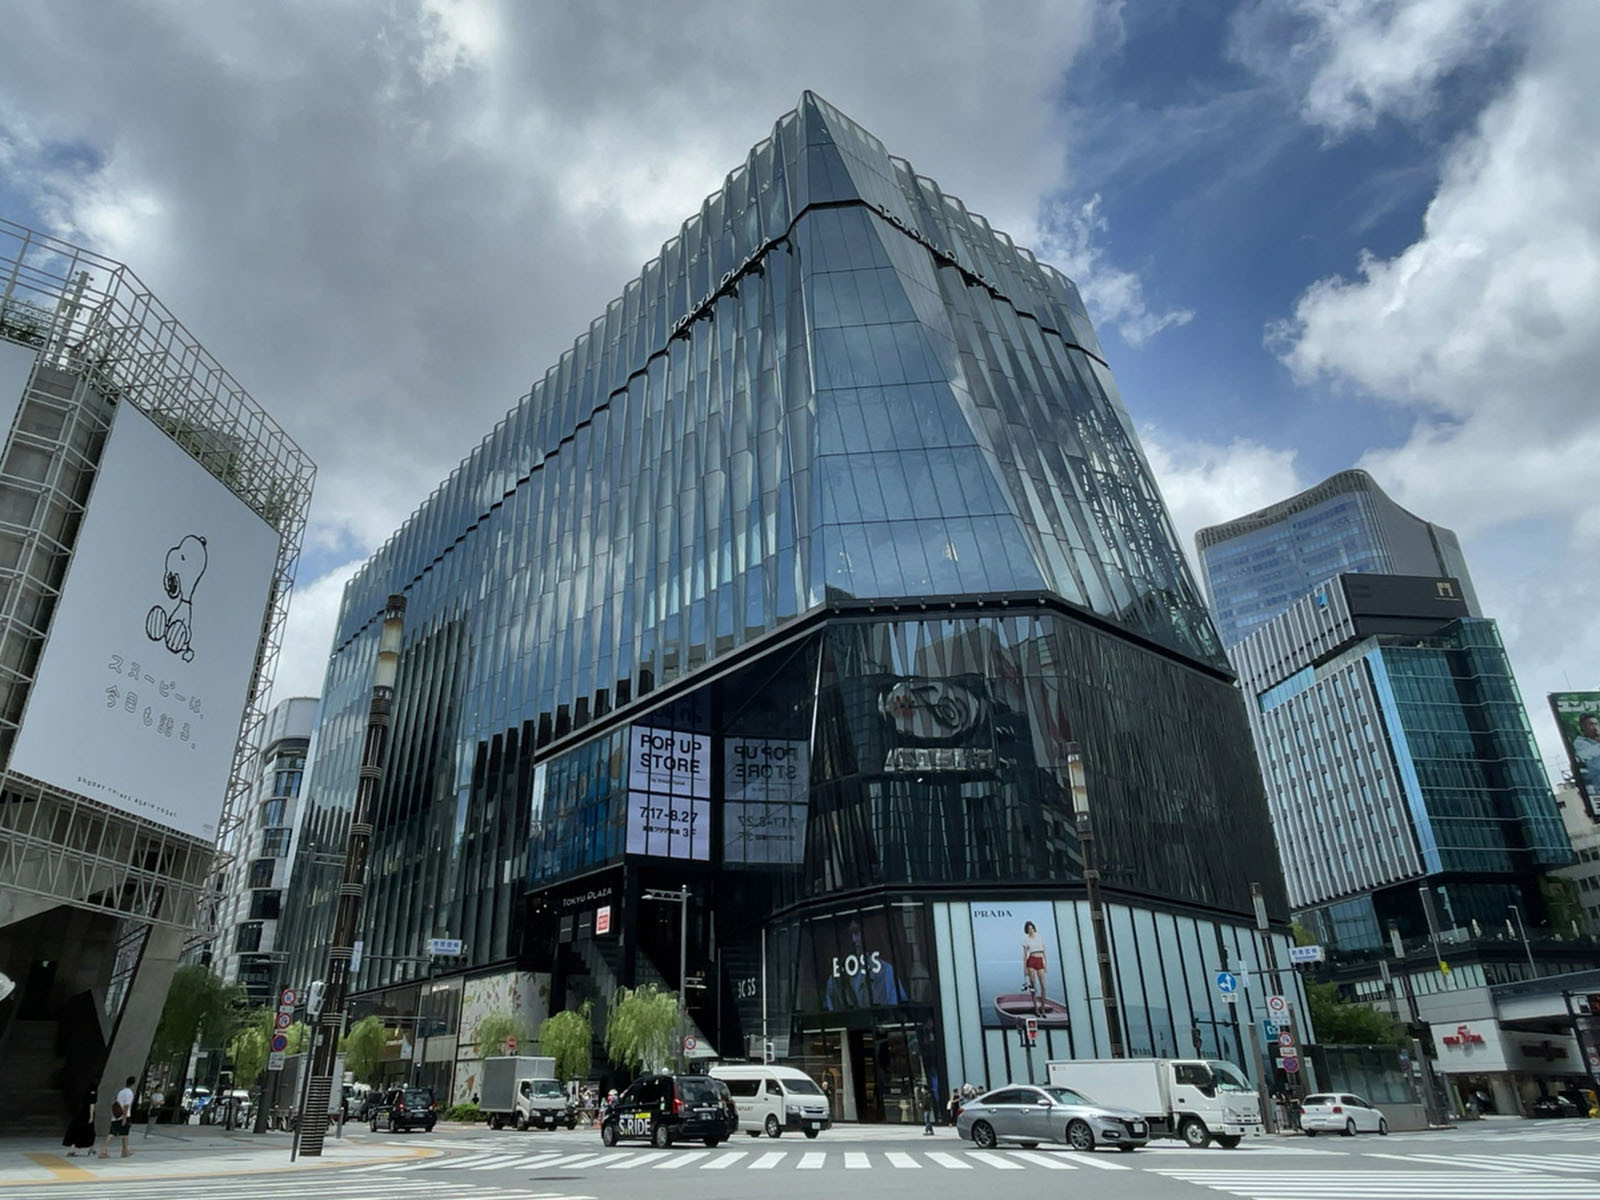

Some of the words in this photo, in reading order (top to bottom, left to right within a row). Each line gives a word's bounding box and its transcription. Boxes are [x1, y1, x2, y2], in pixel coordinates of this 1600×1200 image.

[640, 734, 675, 752] POP
[680, 739, 702, 754] UP
[640, 753, 700, 774] STORE
[563, 895, 586, 907] TOKYU
[587, 888, 612, 900] PLAZA
[974, 910, 1012, 918] PRADA
